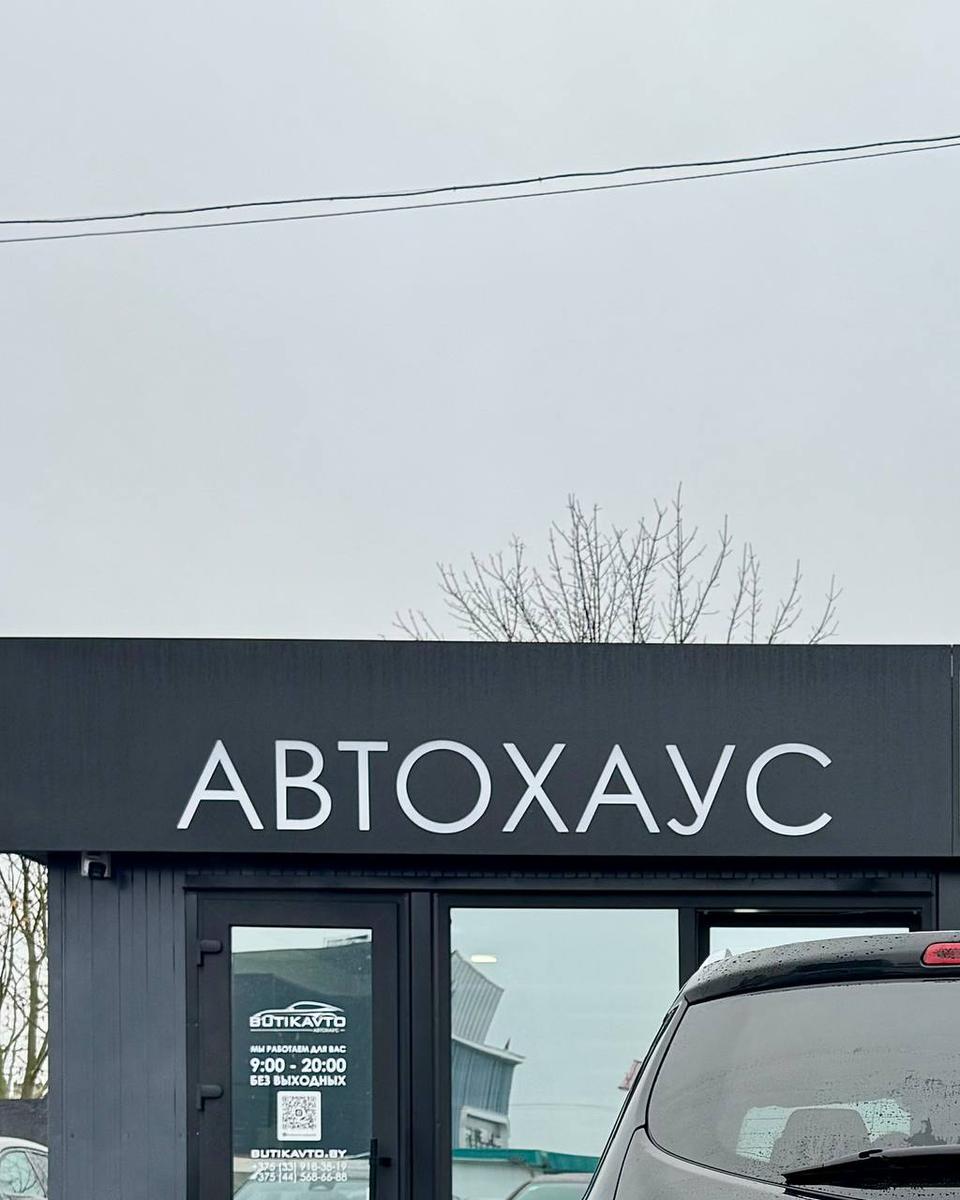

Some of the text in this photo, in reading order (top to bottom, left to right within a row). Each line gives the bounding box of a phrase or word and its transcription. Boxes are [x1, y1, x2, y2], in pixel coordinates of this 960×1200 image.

[176, 738, 833, 837] АВТОХАУС
[249, 1015, 347, 1028] BUTIKAVTO
[250, 1045, 347, 1054] МЫ РАБОТАЕМ ДЛЯ ВАС
[250, 1058, 285, 1073] 9:00
[301, 1058, 347, 1073] 20:00
[250, 1075, 347, 1087] БЕЗ ВЫХОДНЫХ
[250, 1149, 347, 1158] BUTIKAVTO.BY
[300, 1172, 348, 1182] 568-66-88
